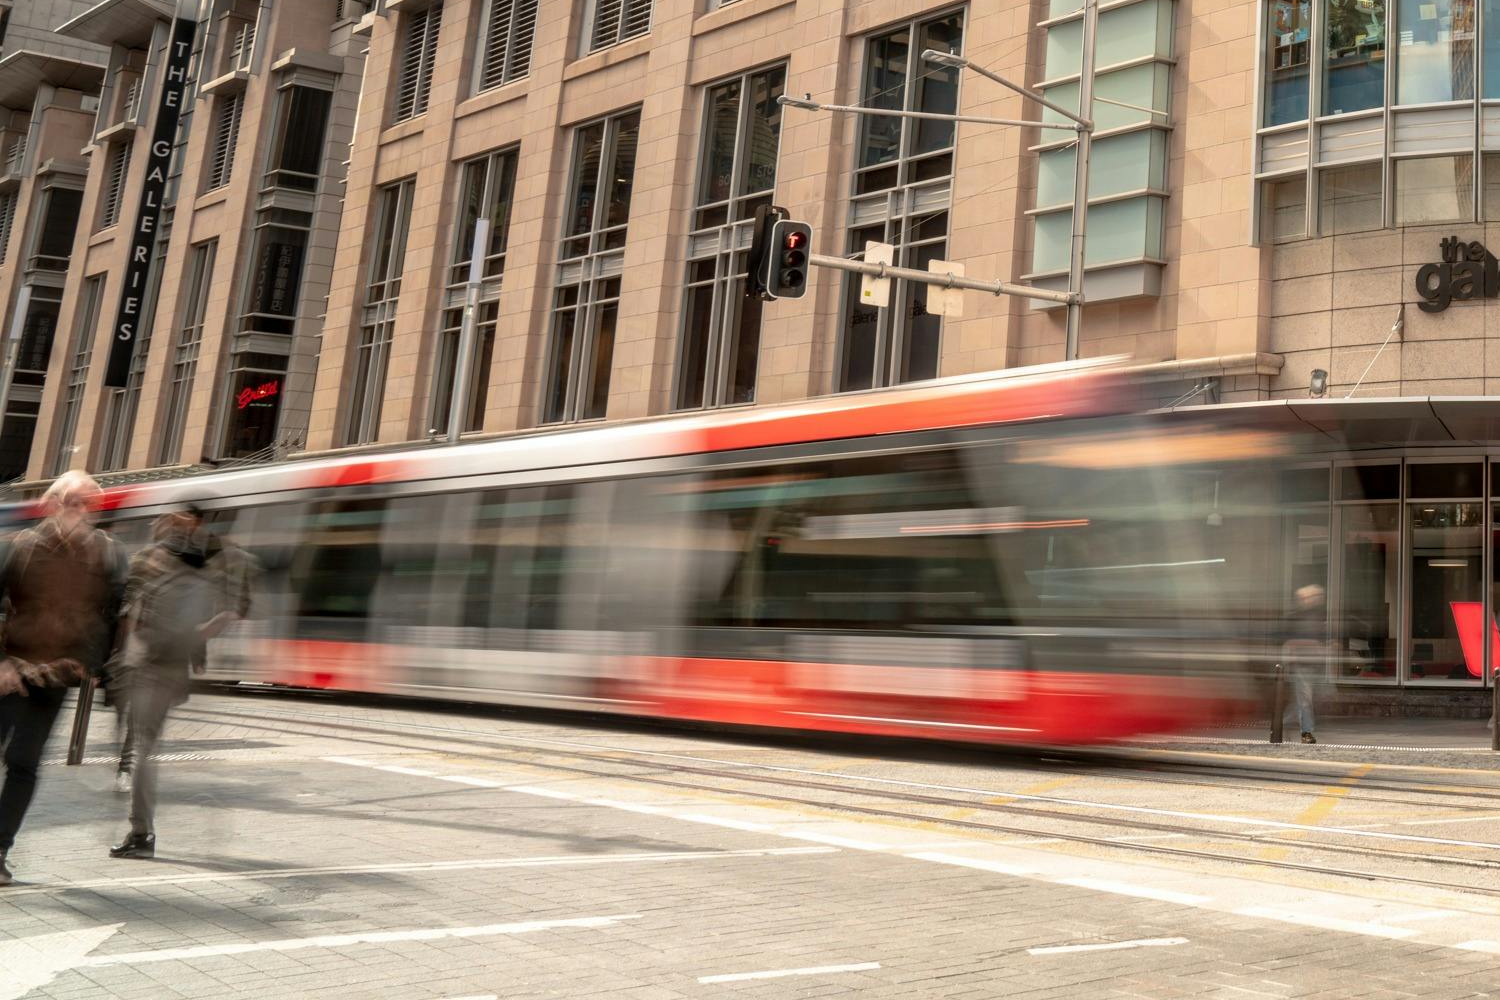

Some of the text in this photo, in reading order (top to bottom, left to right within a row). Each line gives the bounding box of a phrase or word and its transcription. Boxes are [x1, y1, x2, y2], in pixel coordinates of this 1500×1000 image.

[119, 41, 189, 341] THE GALERIES
[1439, 235, 1487, 262] the
